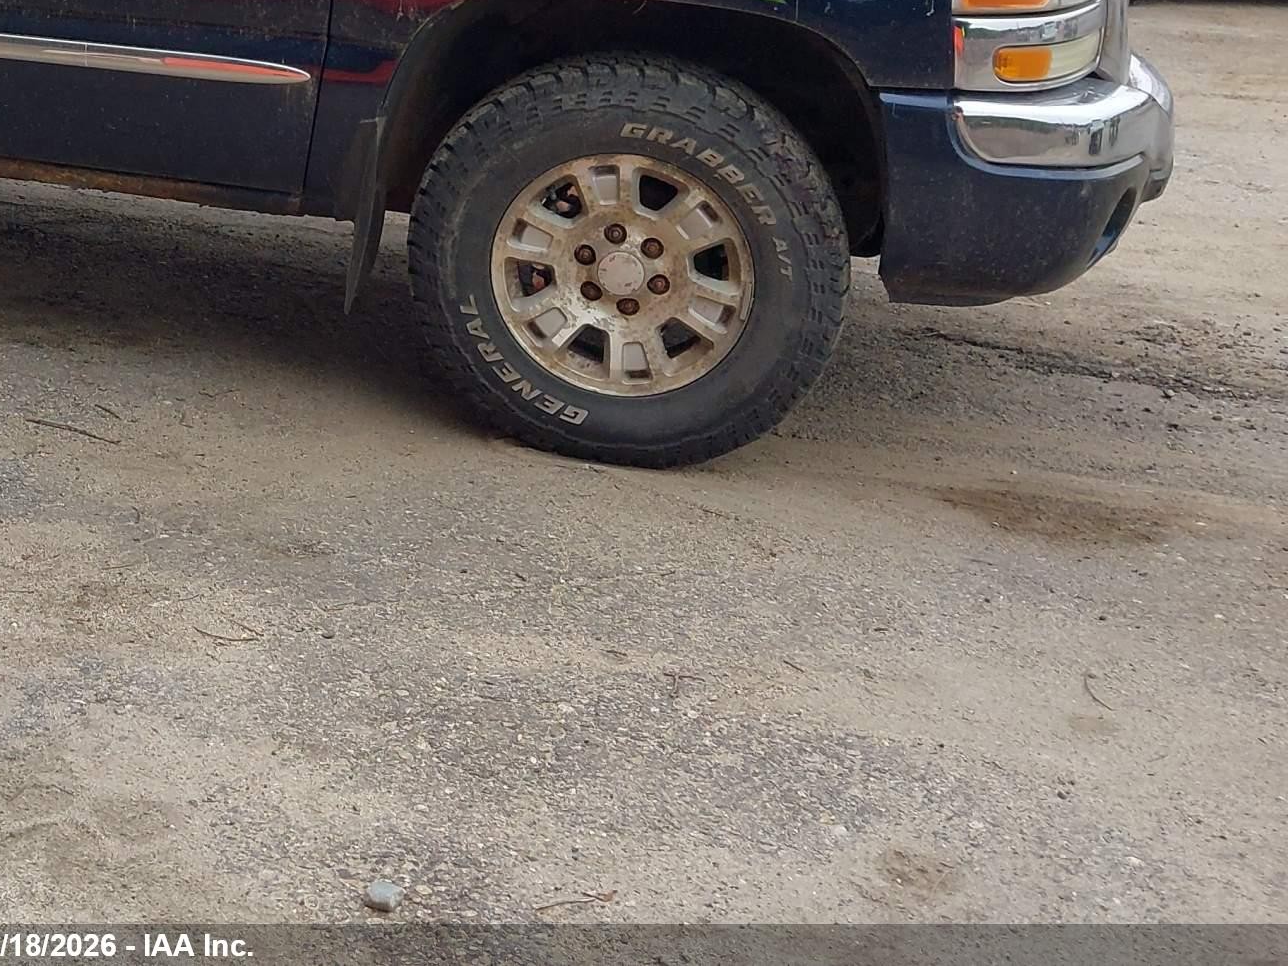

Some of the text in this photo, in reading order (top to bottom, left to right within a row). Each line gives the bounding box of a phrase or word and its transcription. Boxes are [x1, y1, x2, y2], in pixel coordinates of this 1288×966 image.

[619, 122, 793, 282] GRABBER A/T
[459, 294, 589, 426] GENERAL
